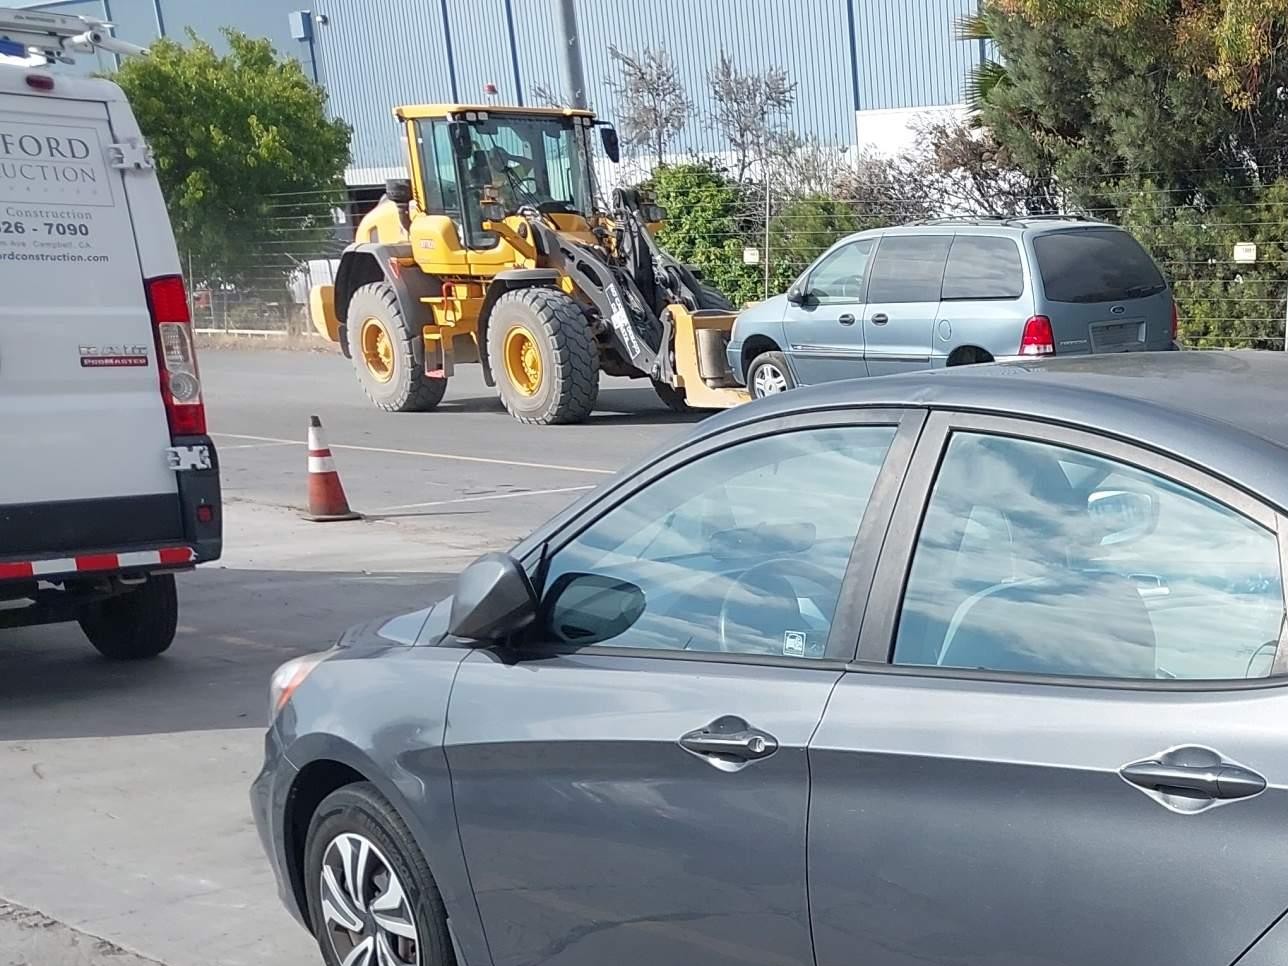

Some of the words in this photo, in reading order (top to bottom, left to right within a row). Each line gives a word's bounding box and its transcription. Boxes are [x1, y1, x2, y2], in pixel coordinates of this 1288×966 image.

[0, 132, 90, 160] FORD
[0, 162, 97, 183] UCTION
[6, 206, 93, 219] Construction
[0, 220, 26, 234] 26
[43, 222, 89, 236] 7090
